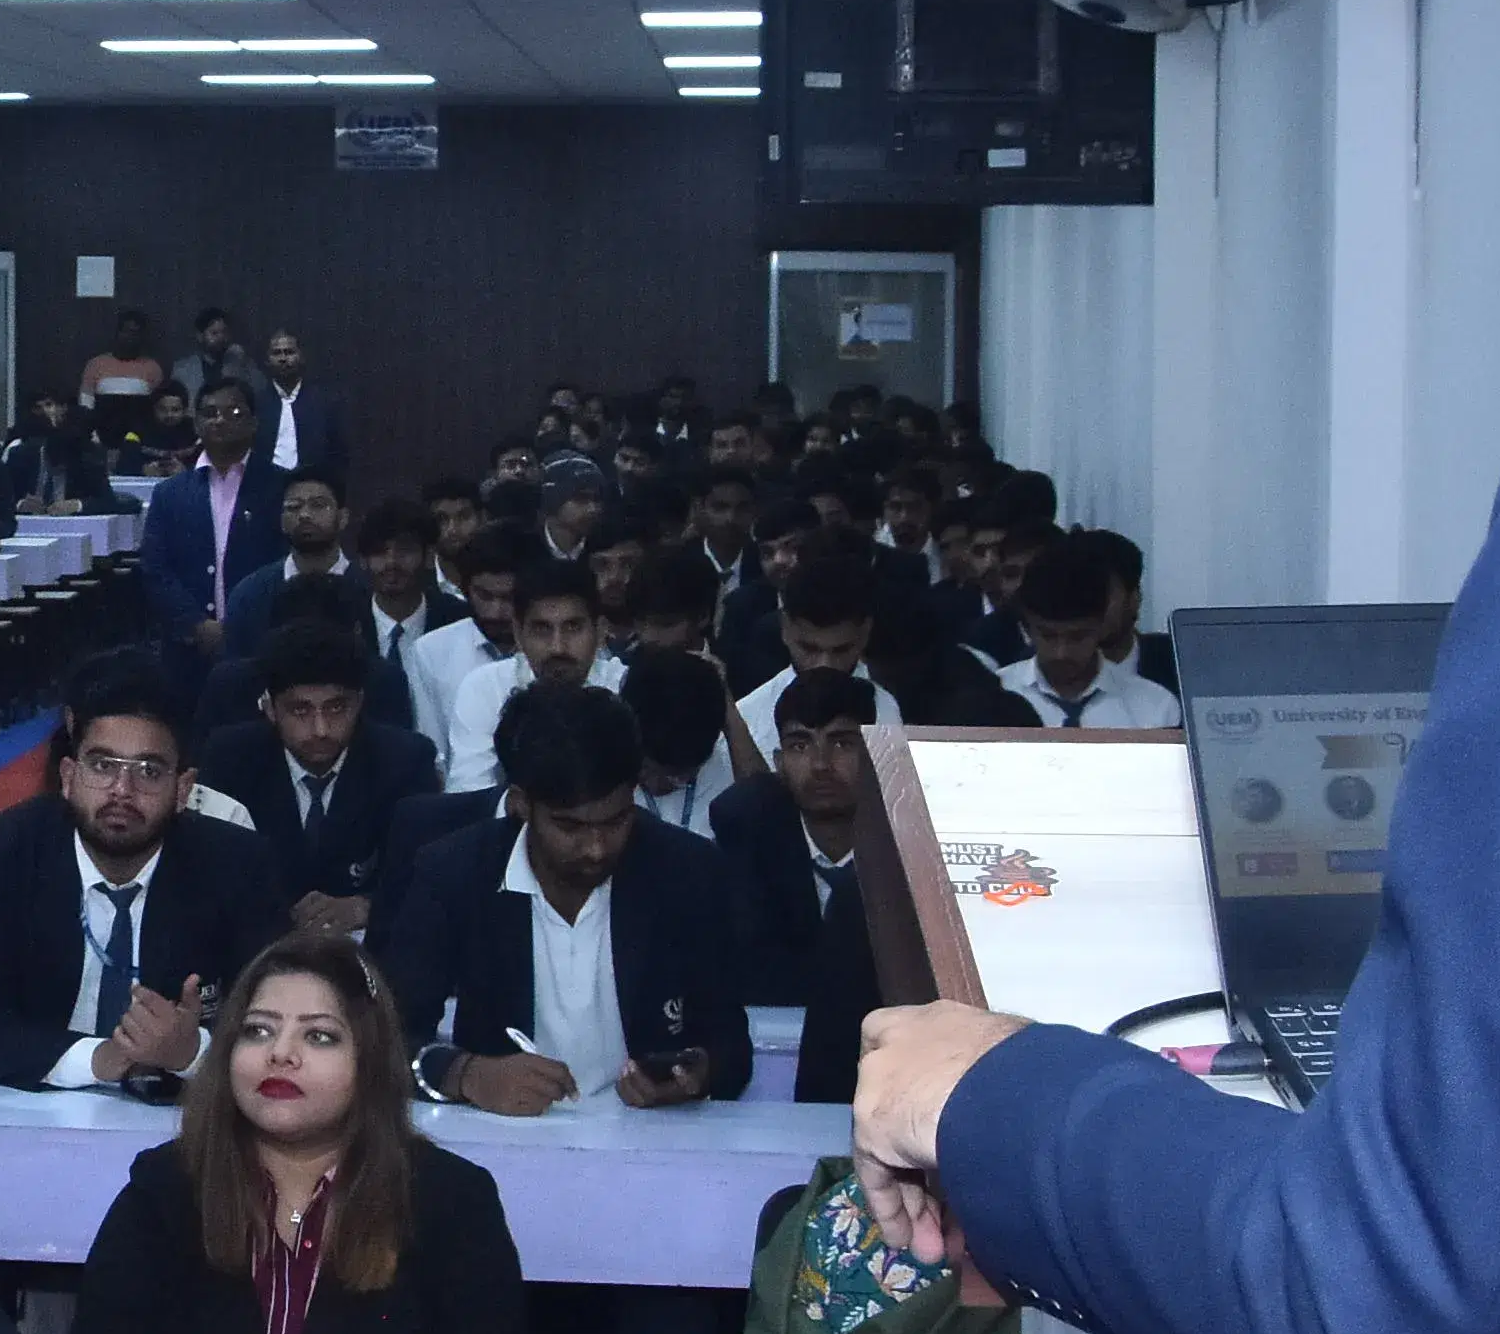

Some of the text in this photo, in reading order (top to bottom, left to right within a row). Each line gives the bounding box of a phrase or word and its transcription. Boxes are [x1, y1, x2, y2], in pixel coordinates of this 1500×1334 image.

[1272, 708, 1366, 724] University
[1373, 707, 1391, 721] of
[941, 844, 999, 854] MUST
[943, 854, 999, 865] HAVE
[954, 883, 982, 894] TO
